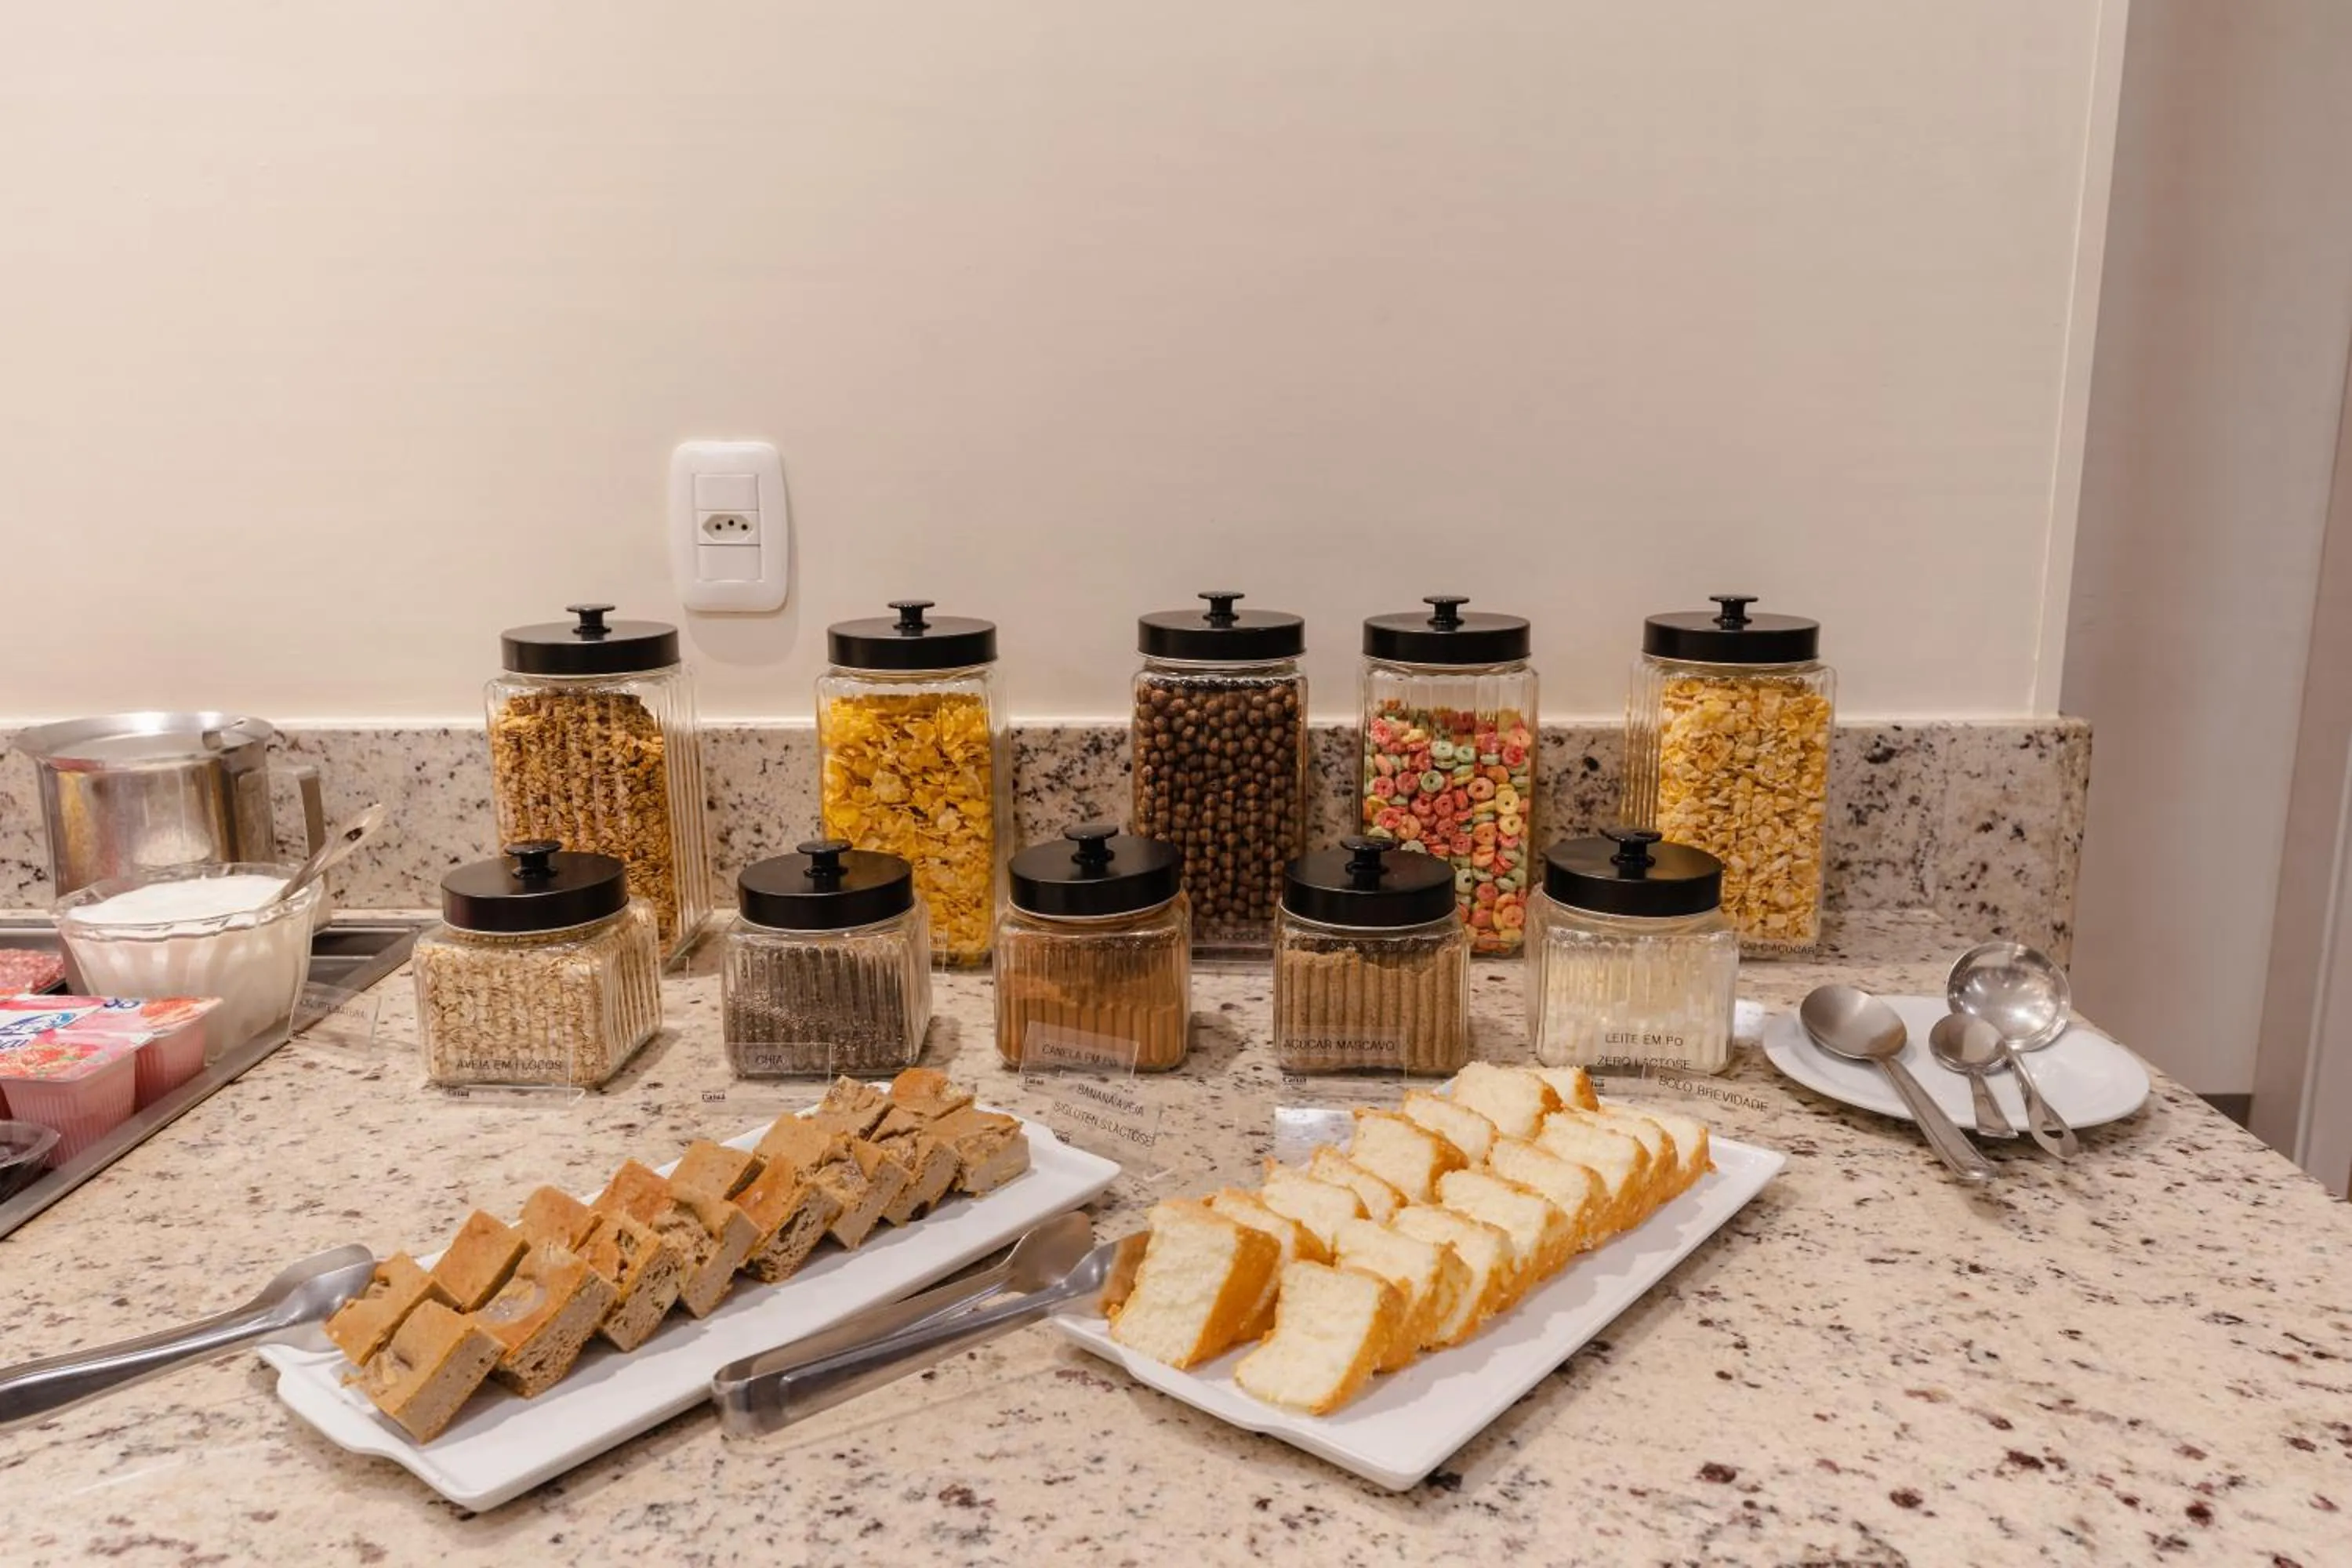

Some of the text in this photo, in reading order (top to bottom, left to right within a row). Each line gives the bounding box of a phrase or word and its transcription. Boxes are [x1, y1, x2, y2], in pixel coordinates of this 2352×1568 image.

[1604, 1033, 1638, 1044] LEITE
[1642, 1034, 1661, 1045] EM
[1336, 1040, 1395, 1051] MASCAVO
[457, 1059, 562, 1071] AVEIA EM FLOCOS
[755, 1054, 786, 1065] CHIA
[1596, 1055, 1691, 1070] ZERO LACTOSE
[1658, 1075, 1769, 1112] BOLO BREVIDADE
